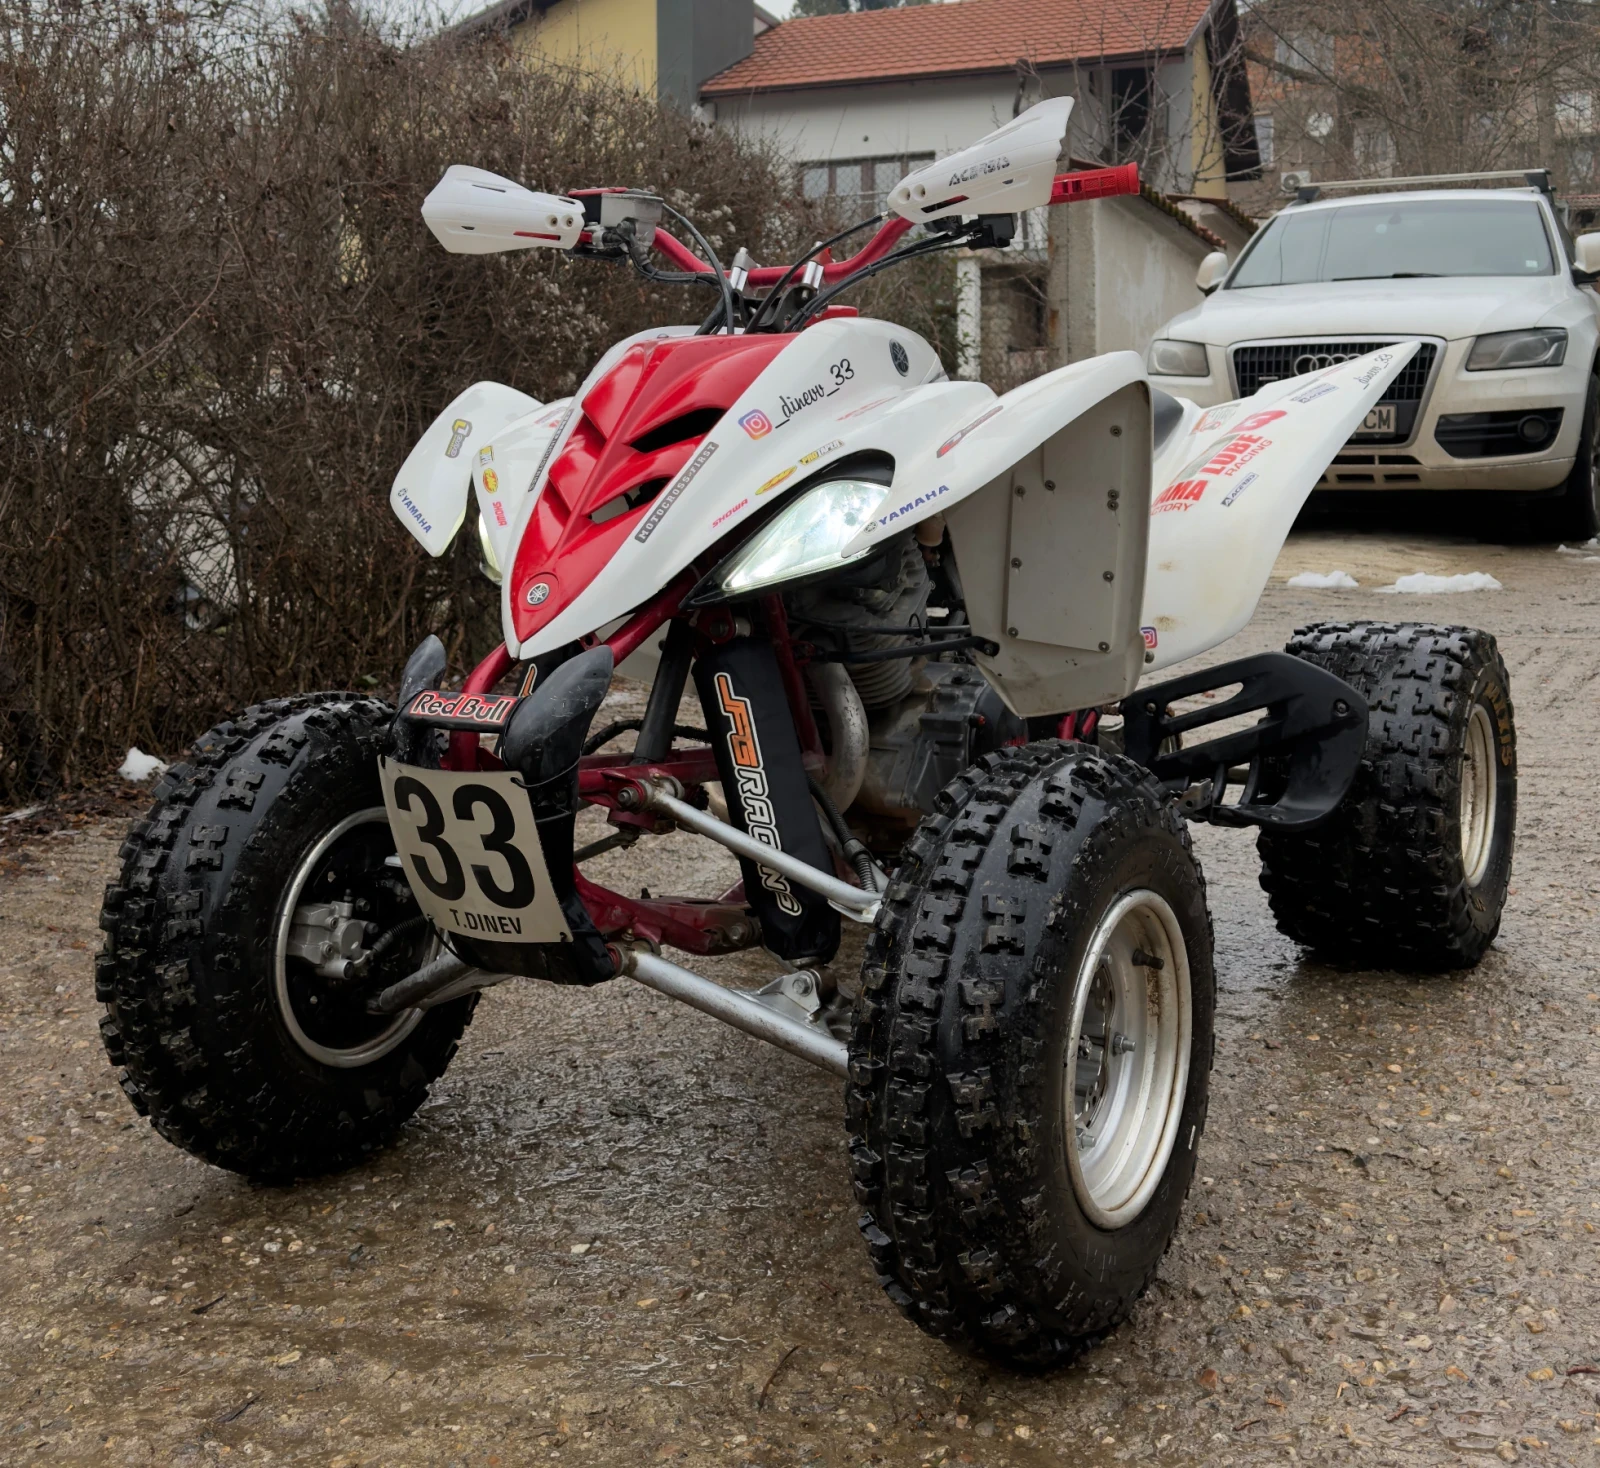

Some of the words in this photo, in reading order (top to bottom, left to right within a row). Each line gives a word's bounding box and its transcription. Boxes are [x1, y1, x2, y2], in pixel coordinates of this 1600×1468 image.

[1200, 434, 1265, 475] LUBE
[1150, 502, 1195, 516] CTORY
[1225, 439, 1273, 477] RACING
[401, 494, 433, 534] YAMAHA
[492, 501, 508, 527] SHOWA
[712, 499, 749, 528] SHOWA
[879, 485, 950, 526] YAMAHA
[411, 692, 464, 717] Red
[456, 696, 512, 722] Bull
[394, 776, 535, 909] 33
[735, 767, 802, 916] RACNG
[449, 908, 522, 935] T.DINEV
